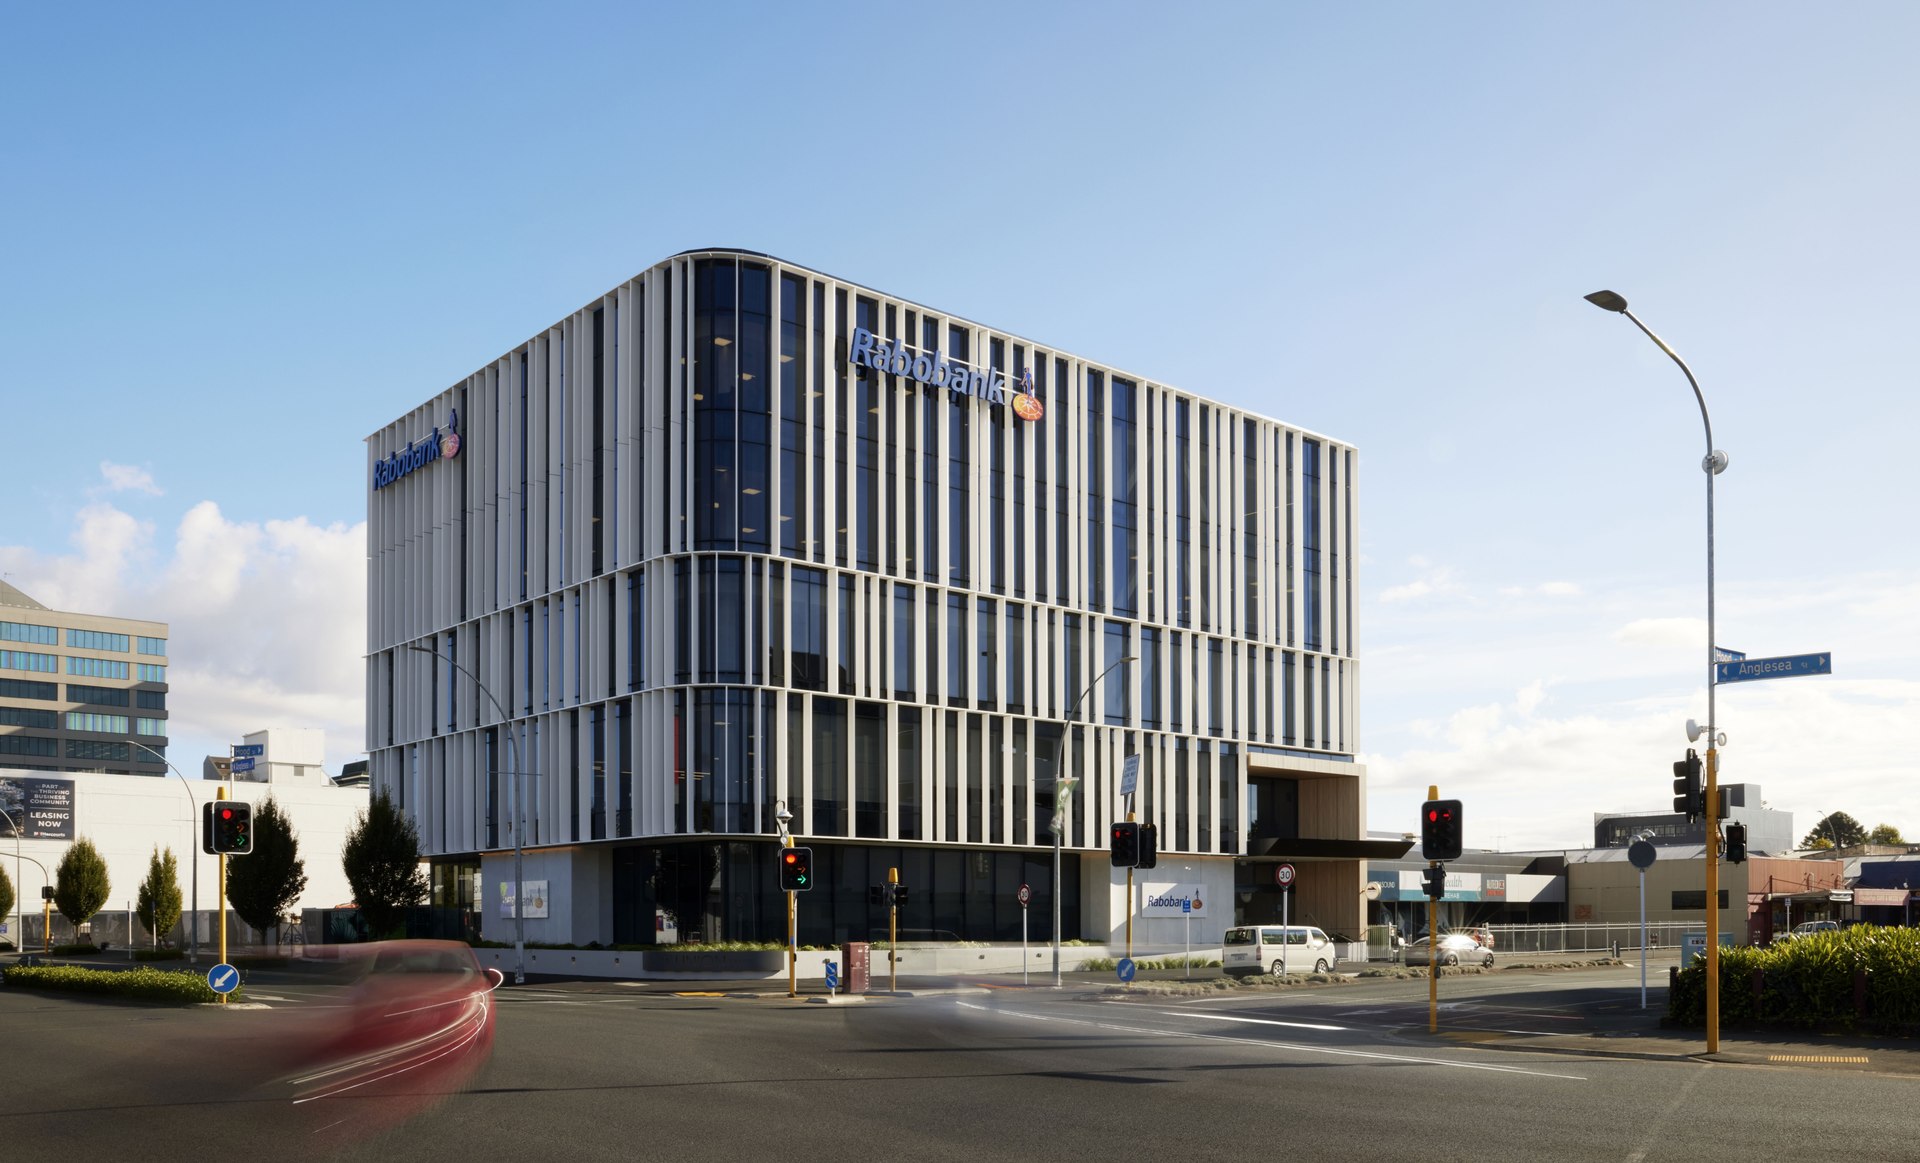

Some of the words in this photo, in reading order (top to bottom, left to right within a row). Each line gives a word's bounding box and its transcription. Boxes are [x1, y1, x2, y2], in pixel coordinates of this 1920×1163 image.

[850, 327, 1005, 404] Rabobank
[374, 427, 442, 491] Rabobank
[1739, 660, 1792, 675] Anglesea
[235, 746, 250, 756] Hood
[1280, 869, 1290, 879] 30
[1021, 890, 1028, 899] 30
